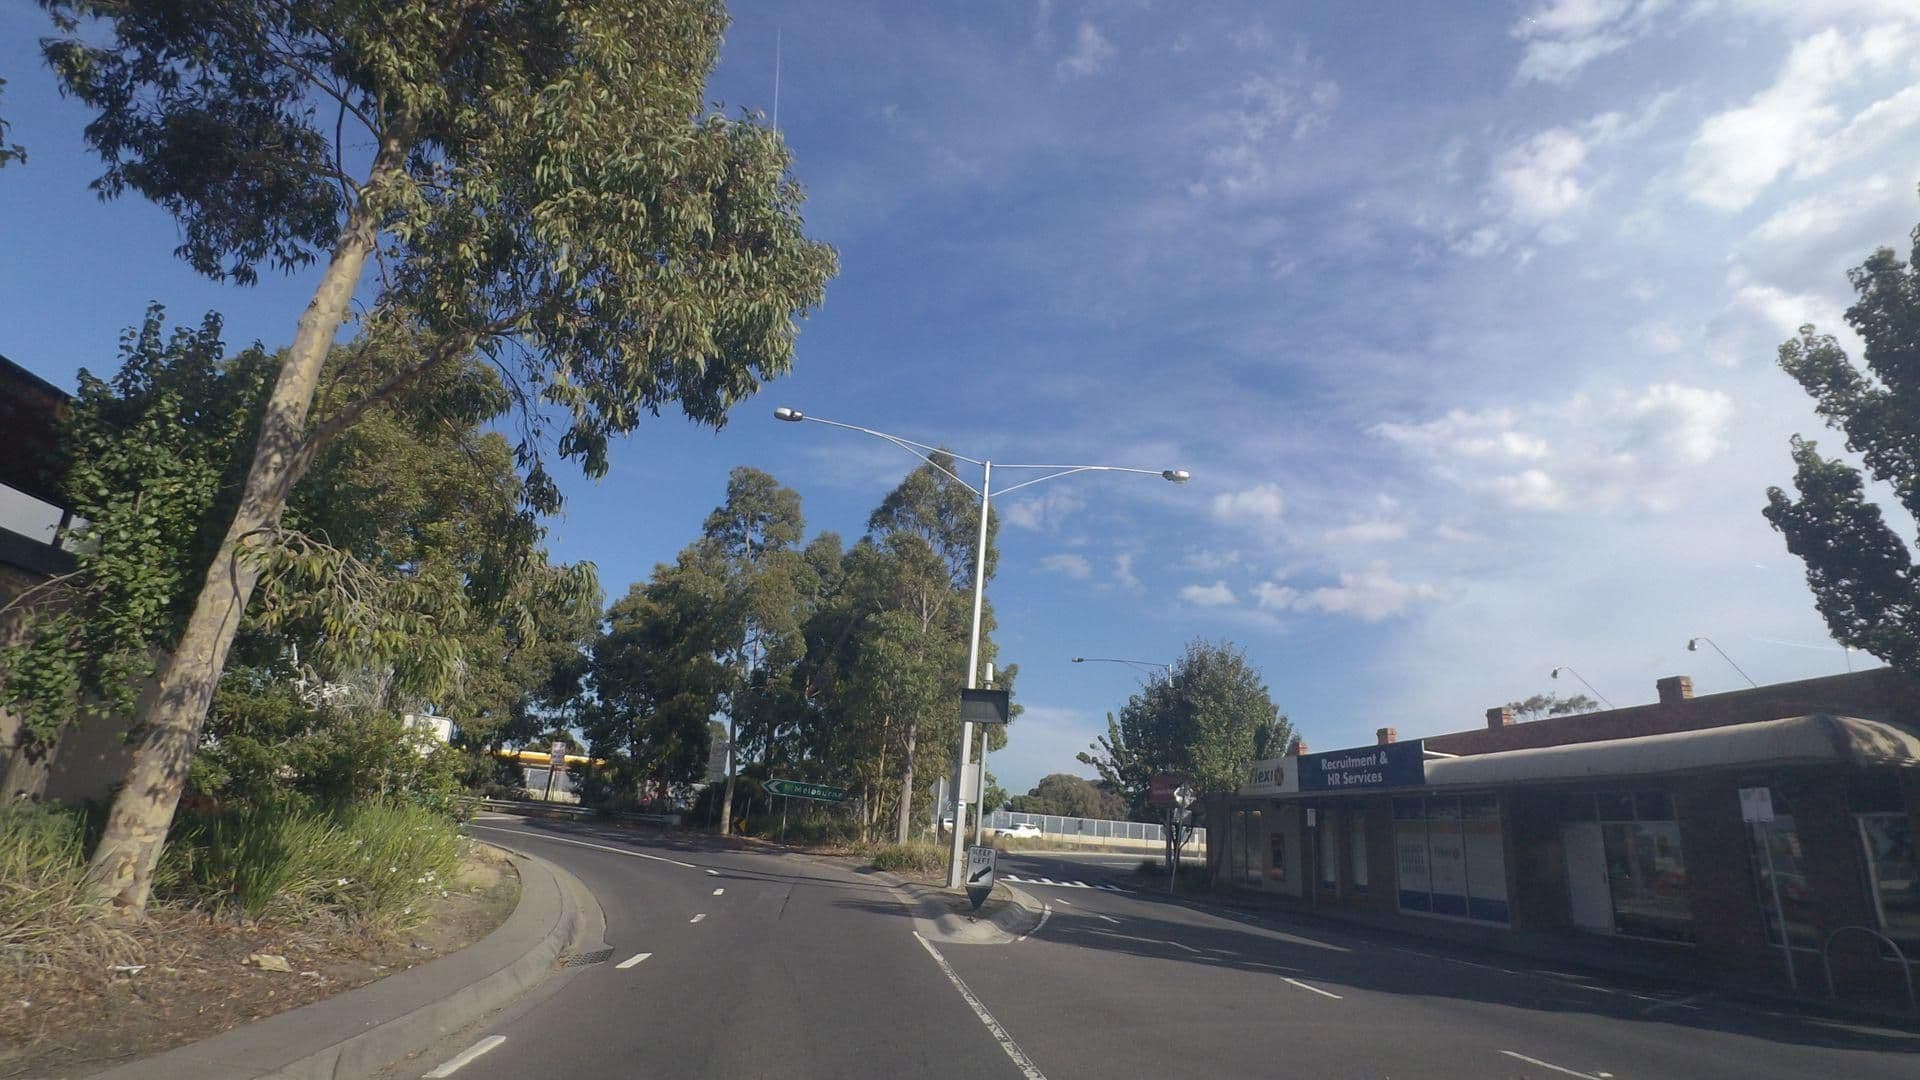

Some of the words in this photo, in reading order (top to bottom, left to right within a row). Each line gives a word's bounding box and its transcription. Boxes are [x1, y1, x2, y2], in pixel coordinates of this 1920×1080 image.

[1321, 754, 1377, 770] Recruitment
[1379, 750, 1388, 764] &
[1327, 773, 1341, 786] HR
[1343, 770, 1383, 784] Services
[794, 785, 842, 799] Melbourne
[972, 847, 992, 857] KEEP
[973, 857, 991, 865] LEFT
